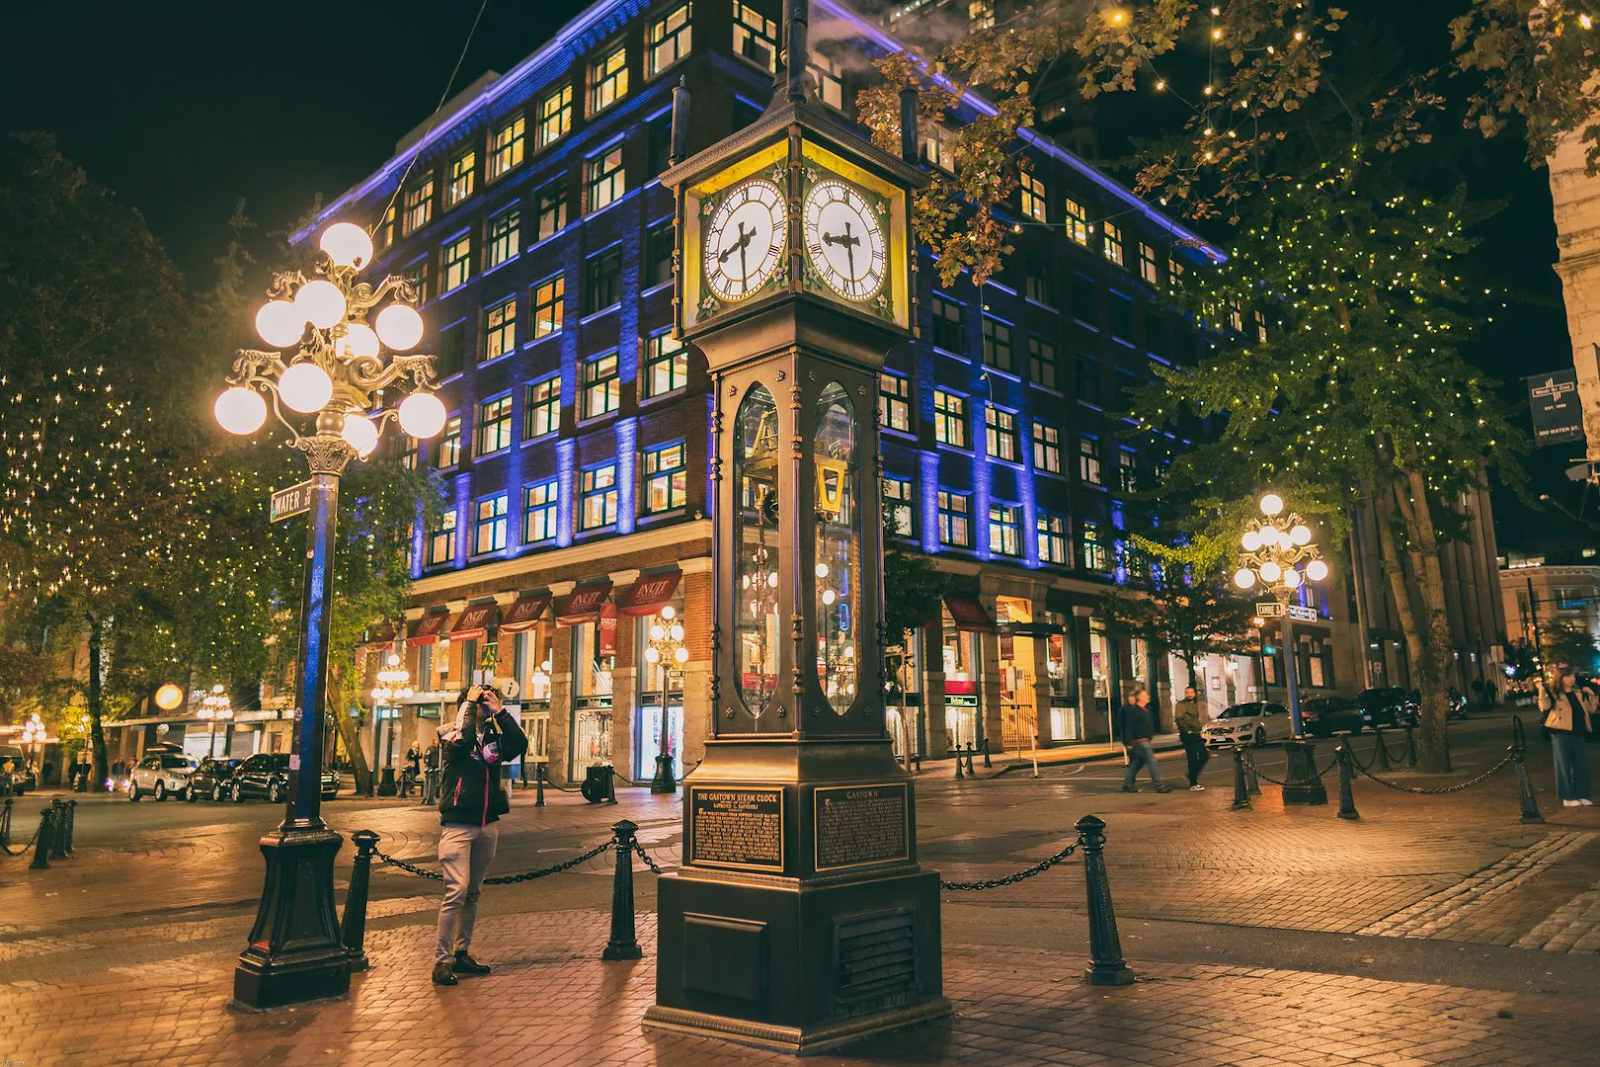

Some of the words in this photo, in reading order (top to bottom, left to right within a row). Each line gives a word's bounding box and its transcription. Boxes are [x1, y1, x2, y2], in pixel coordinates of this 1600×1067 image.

[1550, 426, 1570, 434] WATER
[275, 491, 300, 514] WATER
[637, 581, 669, 595] INUIT
[573, 591, 601, 605] INUIT
[697, 793, 708, 801] THE
[709, 793, 736, 801] GASTOWN
[737, 793, 756, 802] STEAM
[756, 794, 777, 803] CLOCK
[846, 790, 878, 799] GASTOWN
